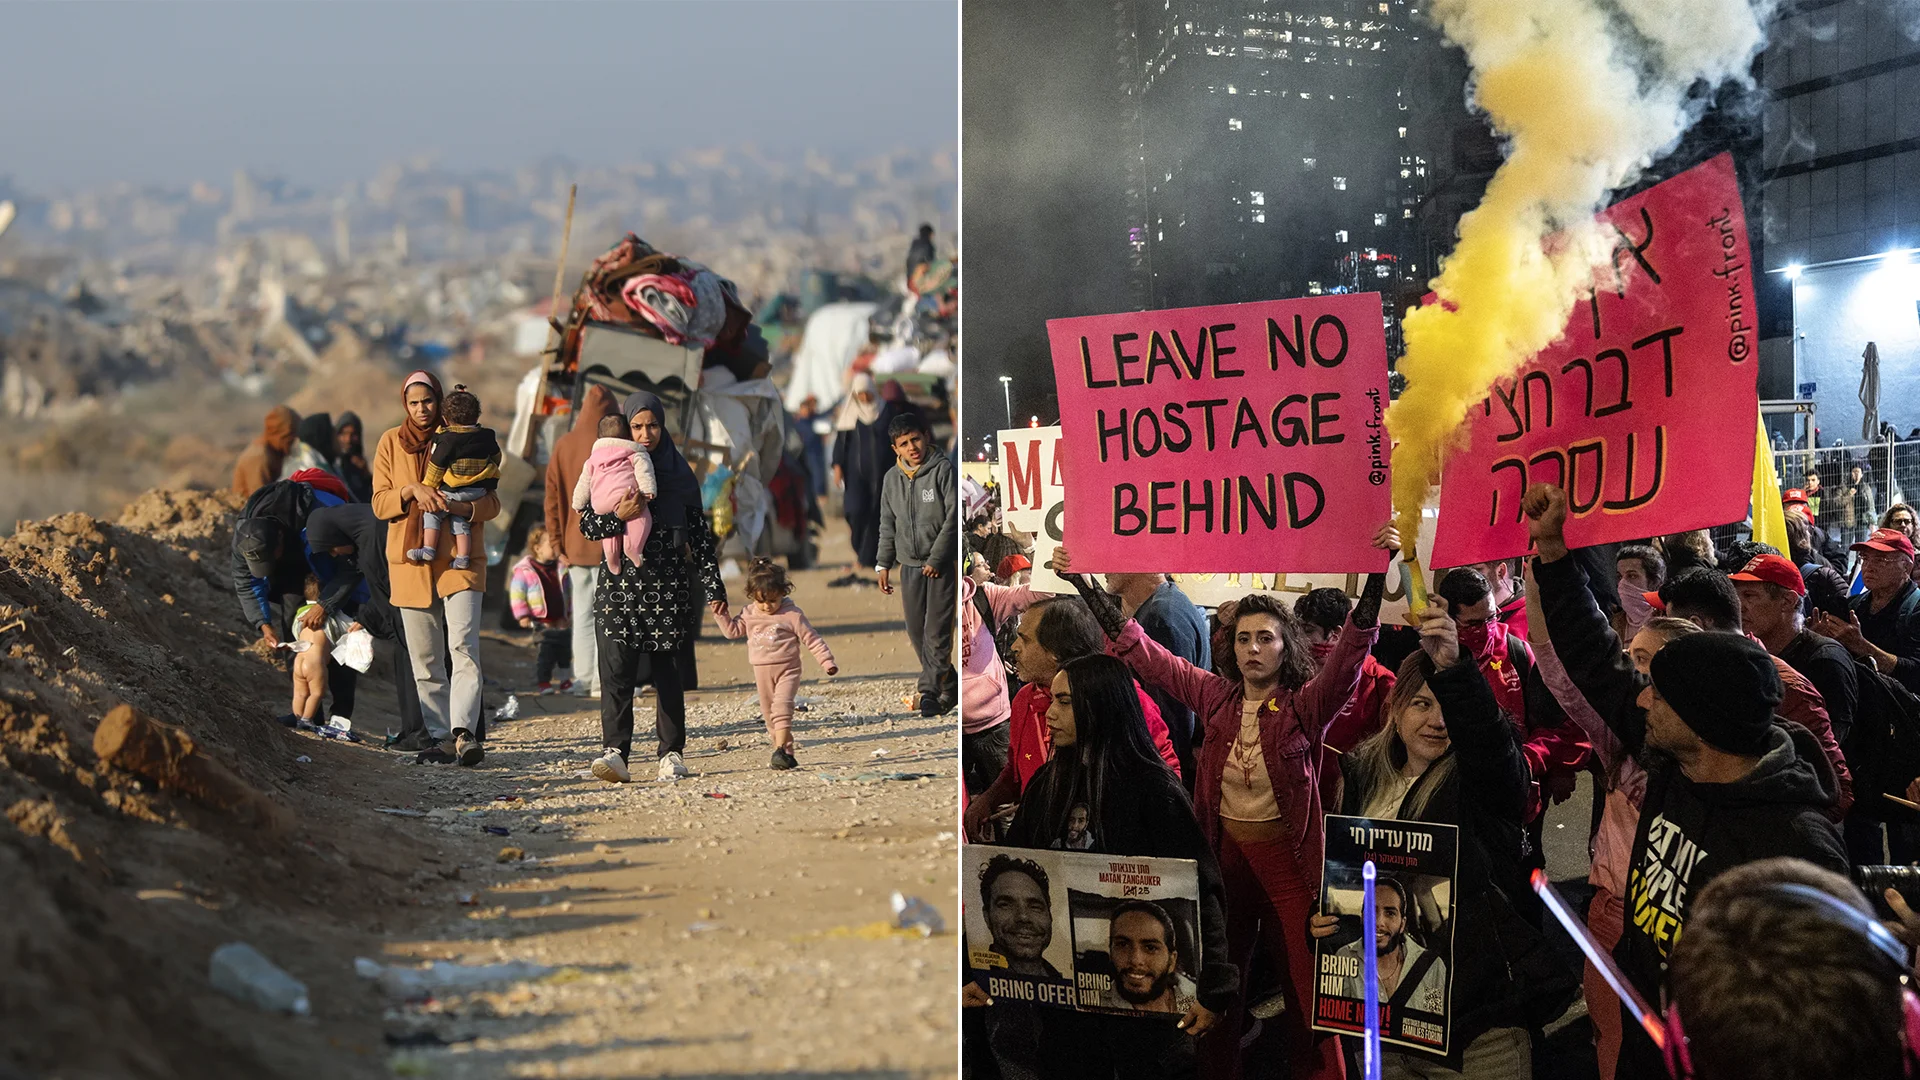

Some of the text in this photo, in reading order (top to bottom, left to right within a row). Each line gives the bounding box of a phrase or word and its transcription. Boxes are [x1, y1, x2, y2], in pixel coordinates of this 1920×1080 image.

[1706, 207, 1752, 363] @pink.front
[1079, 314, 1349, 388] LEAVE NO
[1561, 326, 1684, 418] דבר
[1096, 392, 1345, 462] HOSTAGE
[1369, 387, 1391, 486] @pink.front
[1112, 472, 1325, 536] BEHIND
[1349, 826, 1434, 854] מתן עדיין חי
[1099, 872, 1161, 887] MATAN ZANGAUKER
[1321, 953, 1359, 978] BRING
[988, 976, 1076, 1006] BRING OFER
[1077, 971, 1111, 991] BRING
[1320, 973, 1344, 997] HIM
[1079, 988, 1100, 1007] HIM
[1318, 997, 1353, 1022] HOME
[1402, 1024, 1443, 1043] FAMILIES FORUM
